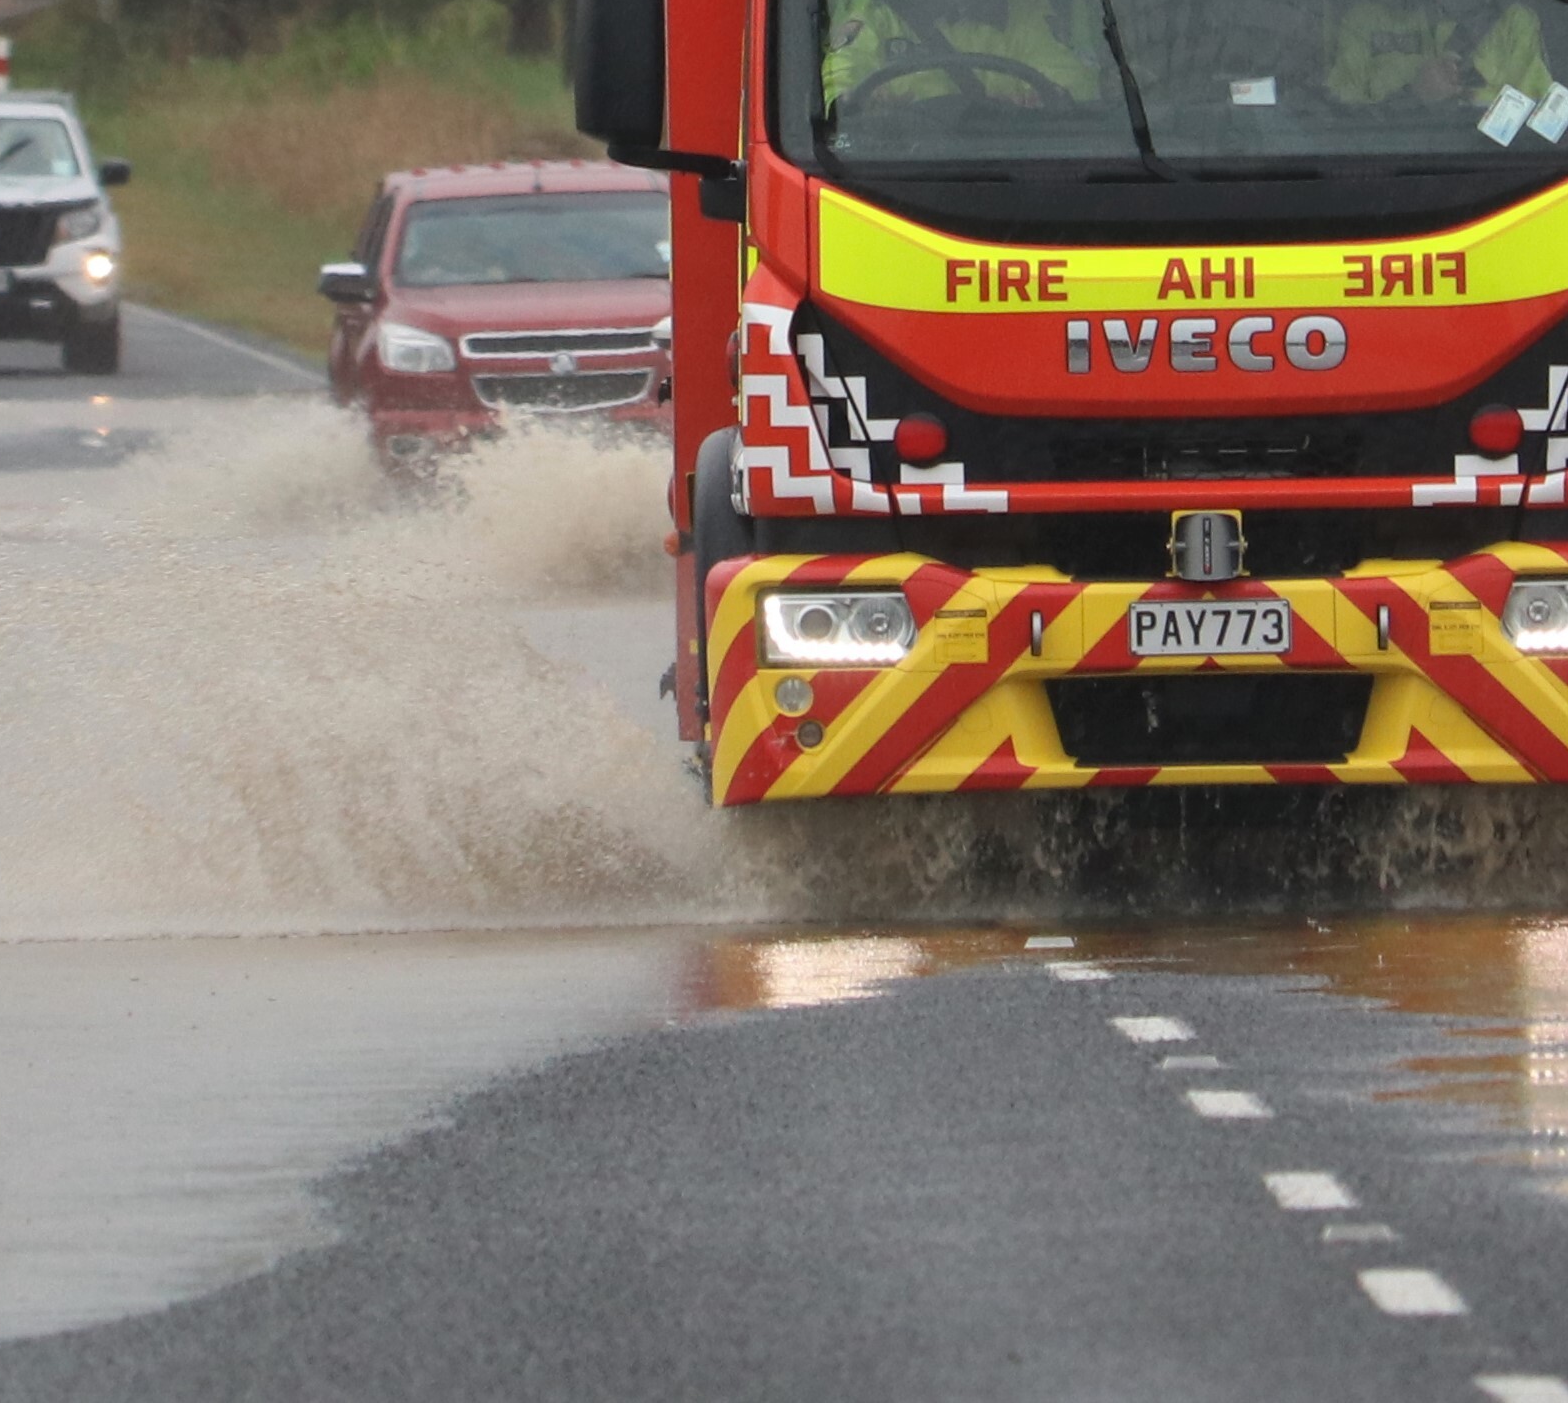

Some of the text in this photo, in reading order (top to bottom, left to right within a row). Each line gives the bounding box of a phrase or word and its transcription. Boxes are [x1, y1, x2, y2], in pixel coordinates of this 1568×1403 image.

[946, 257, 1254, 302] FIRE AHI
[1066, 316, 1347, 374] IVECO
[1136, 608, 1283, 647] PAY773
